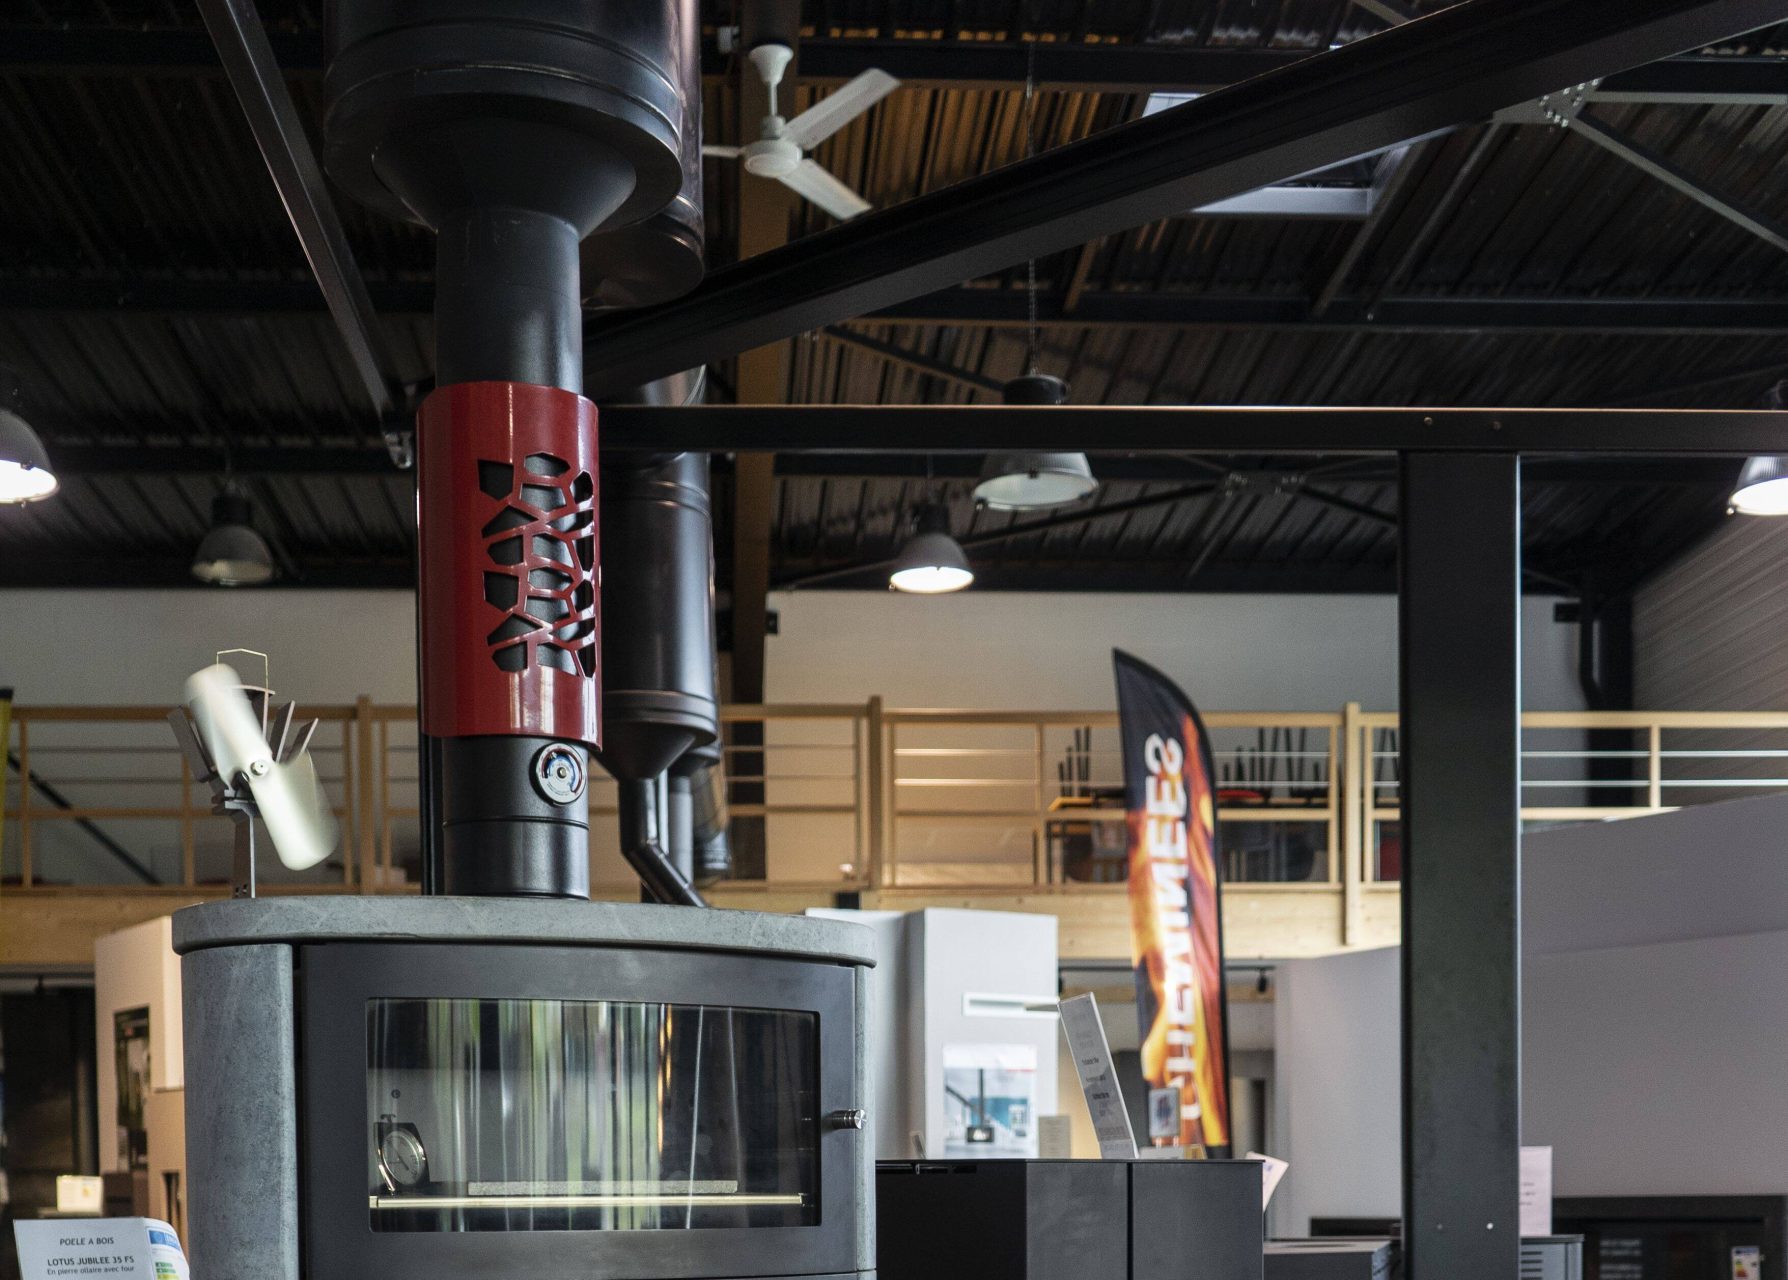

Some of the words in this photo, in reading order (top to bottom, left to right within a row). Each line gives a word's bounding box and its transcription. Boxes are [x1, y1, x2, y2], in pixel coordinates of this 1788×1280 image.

[59, 1237, 86, 1246] POELE
[88, 1237, 94, 1245] A
[96, 1237, 115, 1245] BOIS
[47, 1257, 75, 1267] LOTUS
[77, 1256, 110, 1266] JUBILEE
[124, 1256, 135, 1264] FS
[57, 1267, 79, 1276] pierre
[80, 1266, 102, 1275] ollaire
[121, 1265, 135, 1273] four
